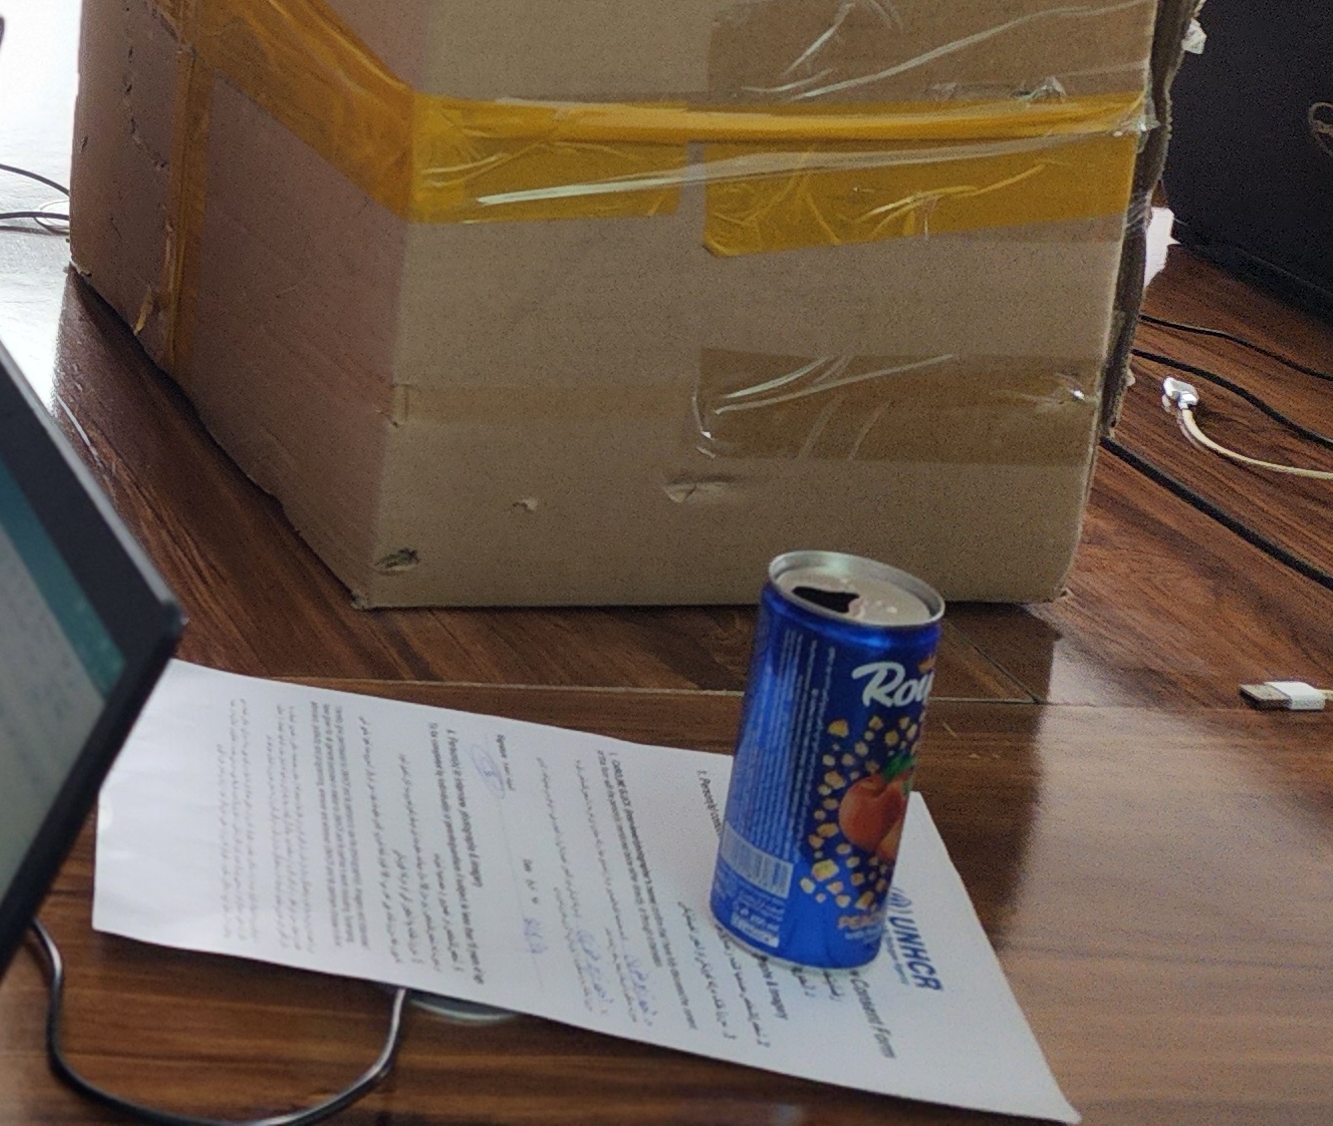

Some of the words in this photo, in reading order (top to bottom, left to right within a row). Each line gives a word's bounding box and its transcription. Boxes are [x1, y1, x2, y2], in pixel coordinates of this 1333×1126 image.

[889, 916, 943, 993] UNHCR
[849, 979, 884, 1024] Consent
[868, 1026, 897, 1058] Form
